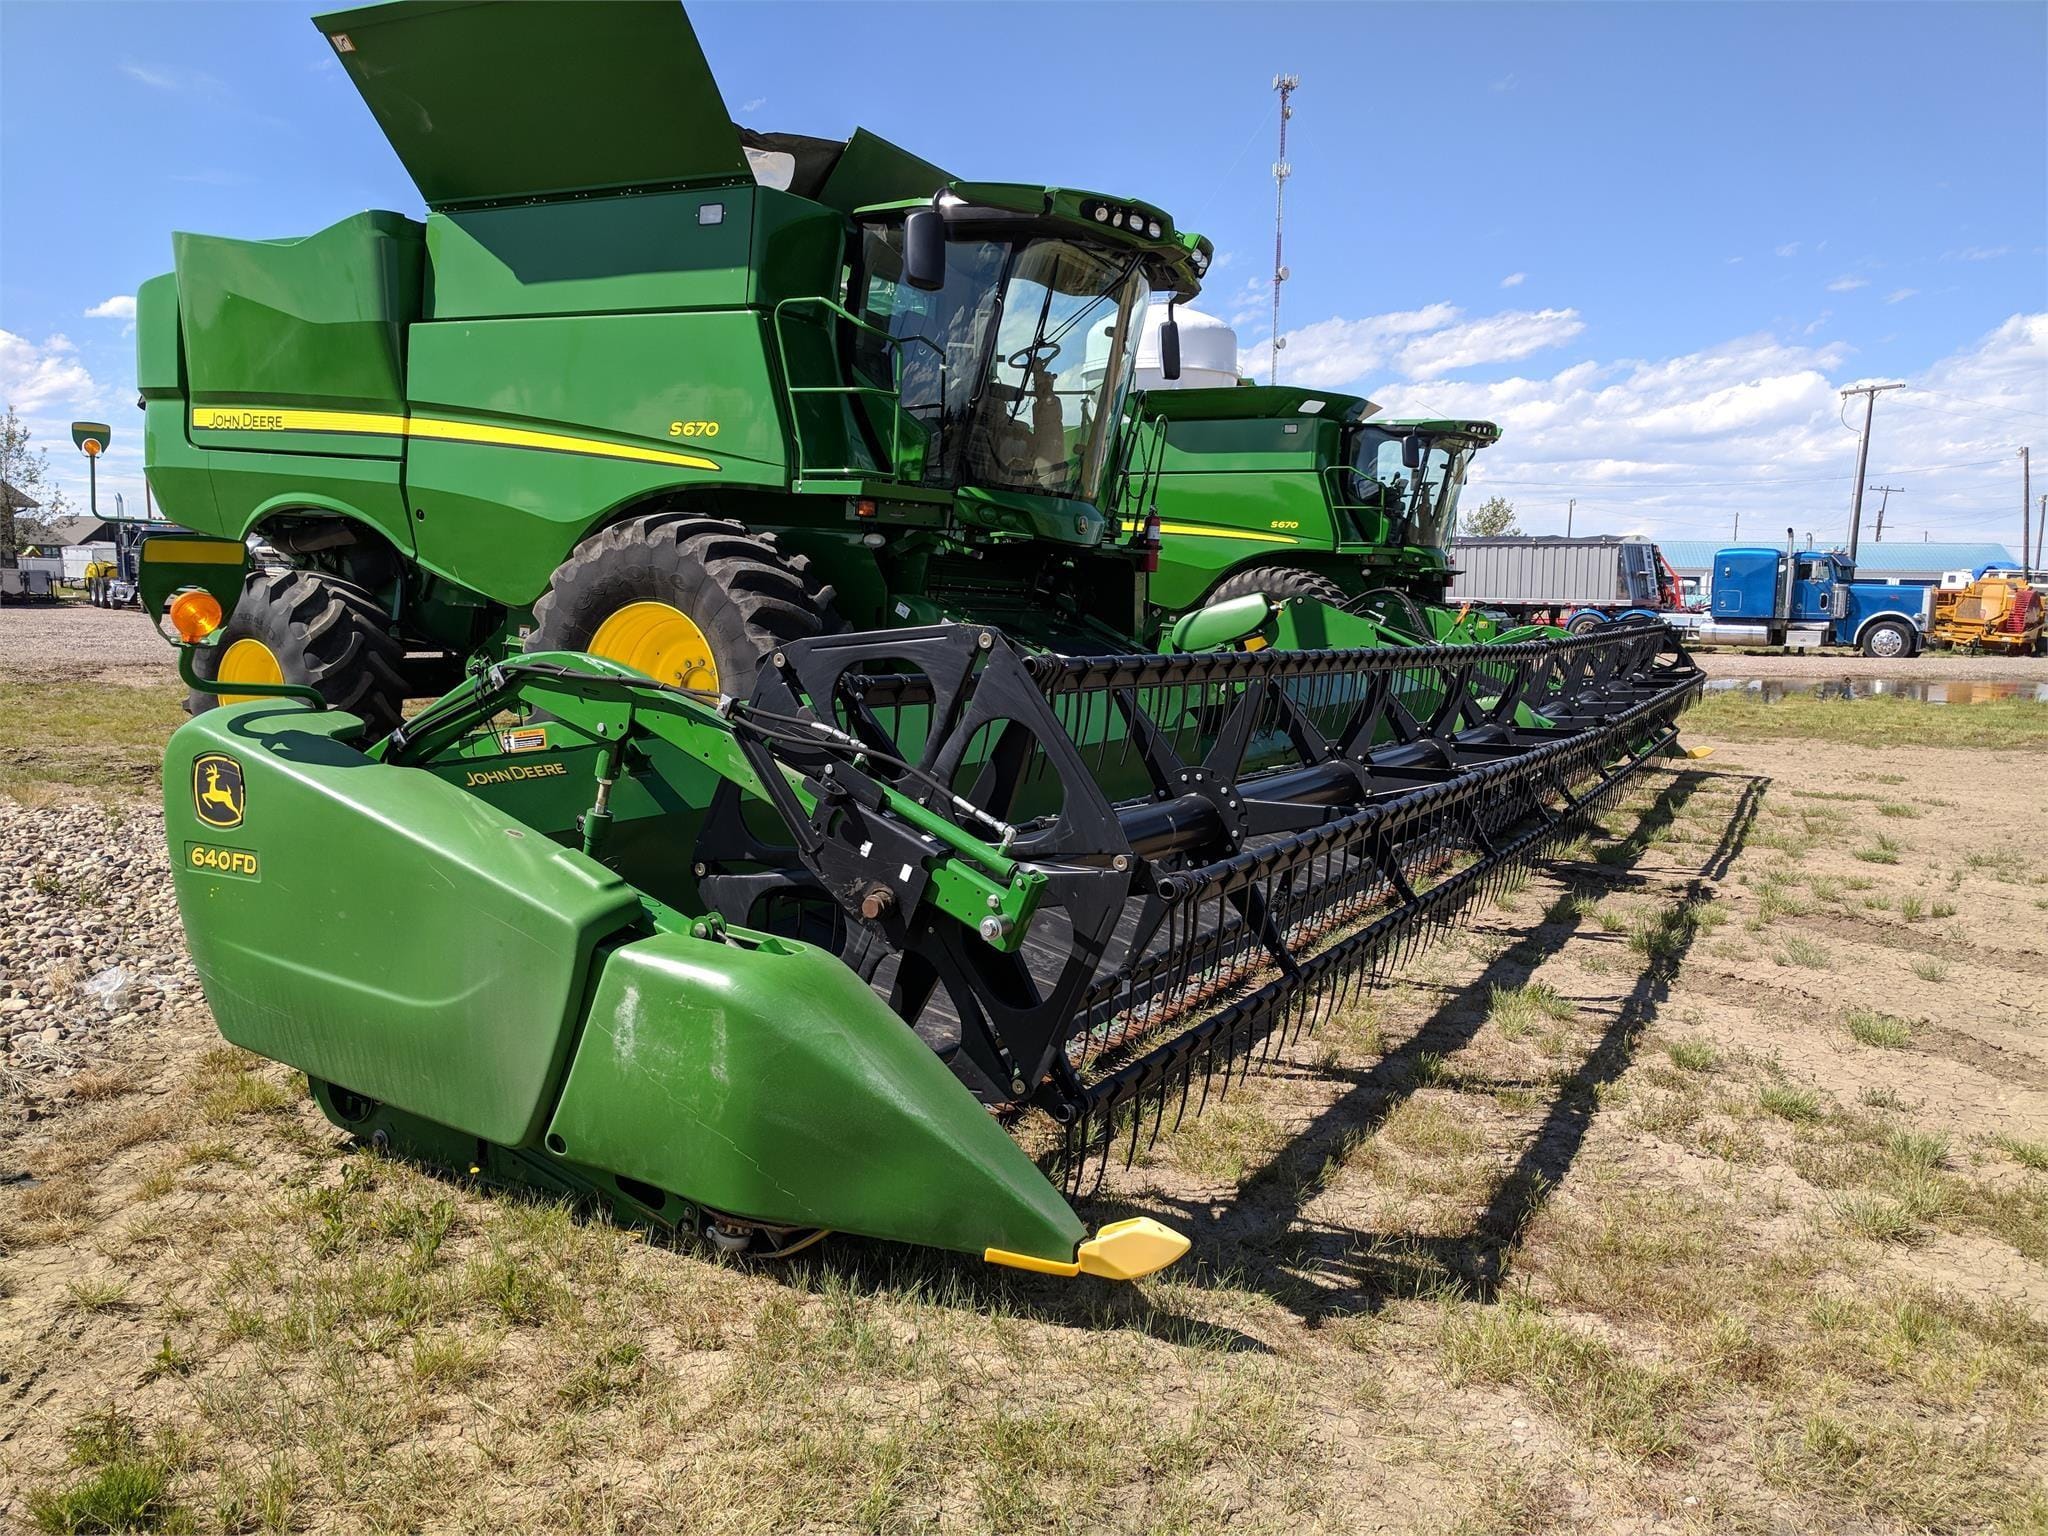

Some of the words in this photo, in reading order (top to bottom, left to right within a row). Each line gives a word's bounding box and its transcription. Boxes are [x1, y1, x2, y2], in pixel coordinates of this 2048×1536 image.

[208, 411, 241, 427] JOHN
[242, 412, 284, 429] DEERE
[669, 420, 720, 437] S670
[1270, 520, 1299, 529] S670
[466, 769, 513, 787] JOHN
[508, 763, 568, 780] DEERE
[191, 846, 258, 875] 640FD
